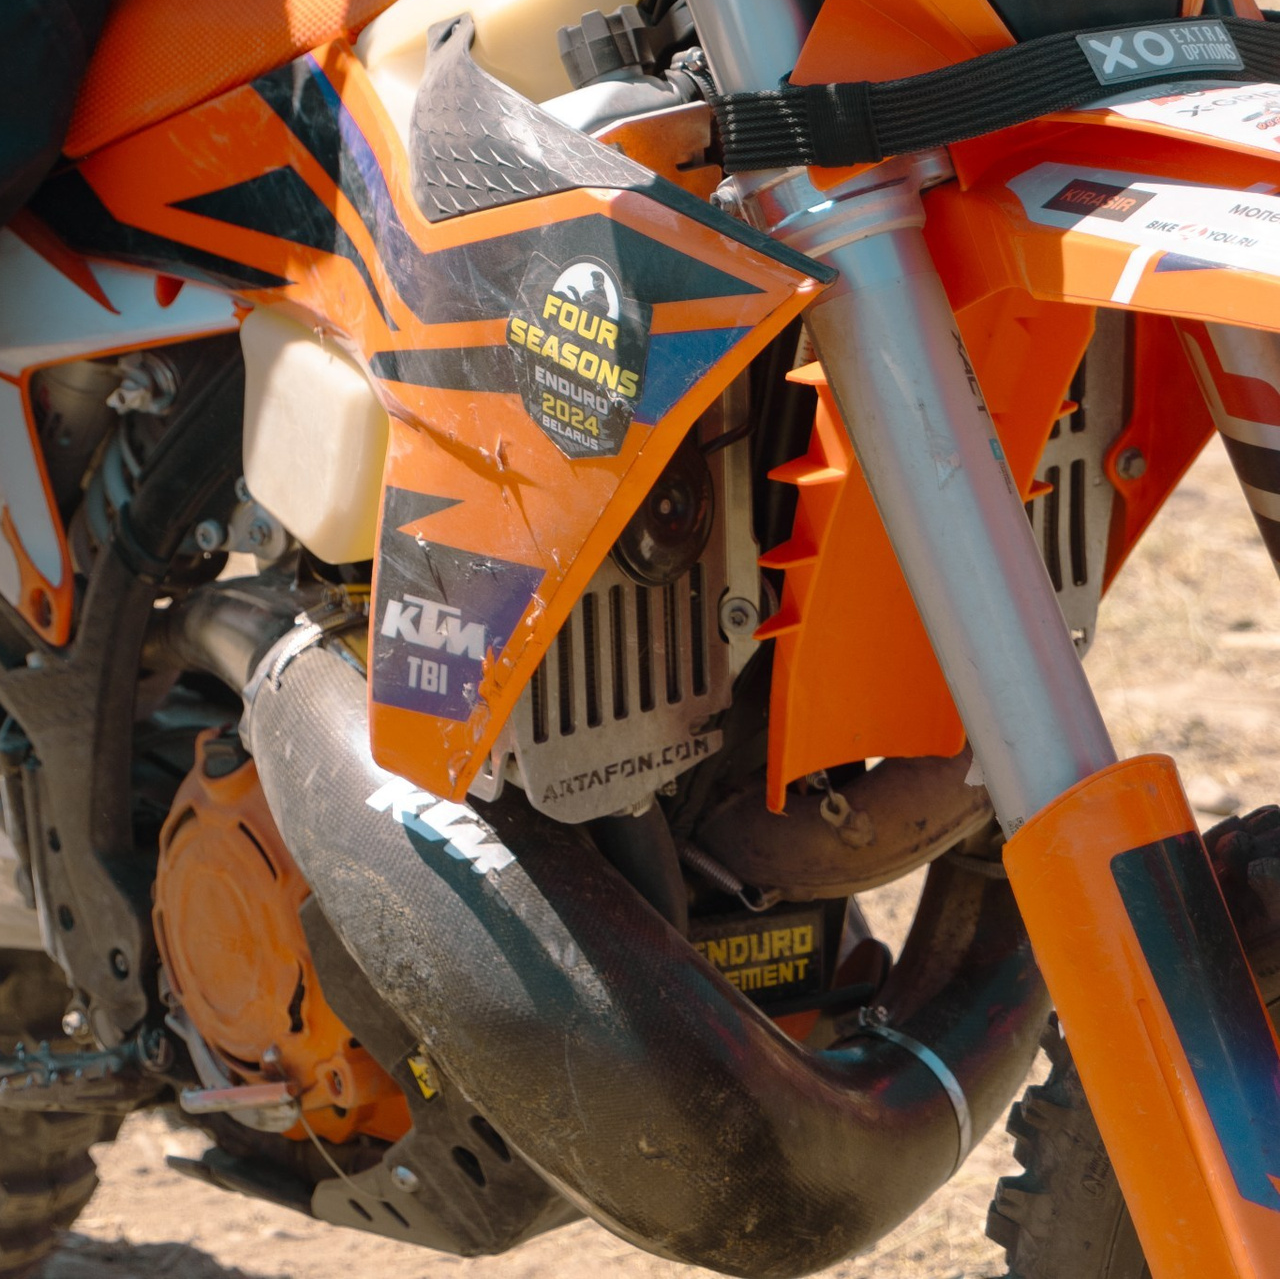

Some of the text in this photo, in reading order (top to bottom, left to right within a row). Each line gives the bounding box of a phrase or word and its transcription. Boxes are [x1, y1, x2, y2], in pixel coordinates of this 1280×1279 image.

[1088, 26, 1228, 75] XO EXTRA
[1181, 43, 1238, 61] OPTIONS
[1059, 188, 1138, 213] KIRASIR
[1144, 220, 1179, 233] BIKE
[1205, 229, 1259, 248] YOU.RU
[543, 294, 619, 350] FOUR
[510, 317, 639, 398] SEASONS
[534, 365, 609, 415] ENDURO
[542, 392, 600, 437] 2024
[542, 414, 599, 451] BELARUS
[381, 593, 486, 661] KTM
[407, 655, 448, 696] TBI
[541, 736, 709, 804] ARTAFON.COM
[365, 776, 518, 874] KTM
[724, 958, 809, 992] EMENT
